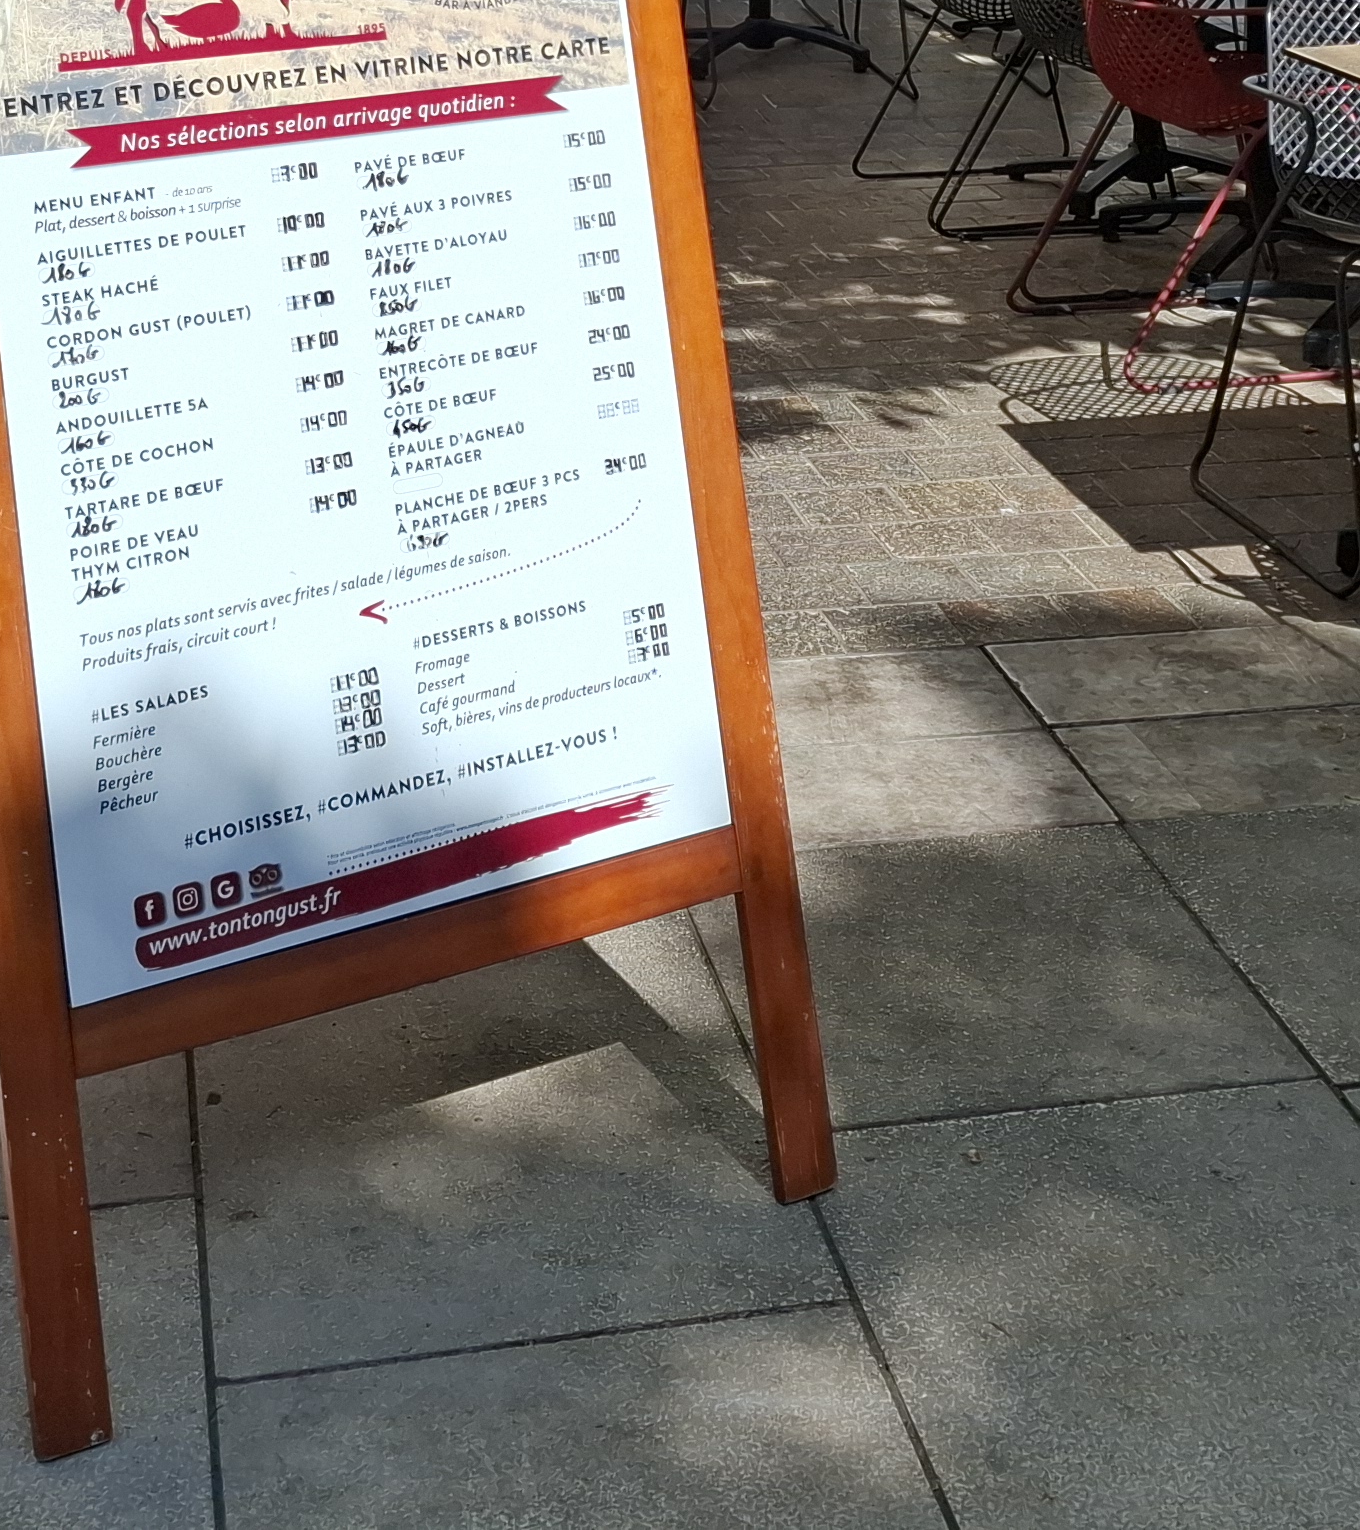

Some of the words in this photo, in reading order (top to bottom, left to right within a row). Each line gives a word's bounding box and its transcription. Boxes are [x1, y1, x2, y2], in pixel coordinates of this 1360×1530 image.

[60, 49, 111, 63] DEPUIS
[357, 23, 386, 35] 1895
[4, 88, 104, 117] ENTREZ
[115, 85, 141, 105] ET
[153, 68, 305, 101] DÉCOUVREZ
[316, 64, 345, 83] EN
[355, 54, 448, 77] VITRINE
[457, 45, 530, 69] NOTRE
[541, 37, 607, 59] CARTE
[121, 133, 159, 152] Nos
[167, 121, 268, 146] sélections
[275, 113, 326, 134] selon
[333, 106, 411, 127] arrivage
[418, 93, 503, 122] quotidien
[354, 154, 392, 173] PAVÉ
[397, 154, 416, 170] DE
[422, 148, 465, 165] BŒUF
[33, 195, 83, 214] MENU
[90, 186, 155, 206] ENFANT
[360, 201, 398, 221] PAVÉ
[403, 199, 433, 215] AUX
[451, 189, 512, 209] POIVRES
[37, 237, 152, 265] AIGUILLETTES
[158, 233, 179, 248] DE
[185, 224, 245, 245] POULET
[364, 240, 429, 260] BAVETTE
[434, 229, 507, 250] D'ALOYAU
[42, 287, 95, 307] STEAK
[100, 275, 159, 298] HACHÉ
[369, 282, 409, 300] FAUX
[414, 276, 451, 293] FILET
[46, 325, 122, 349] CORDON
[128, 318, 170, 336] GUST
[176, 304, 251, 331] (POULET)
[374, 318, 434, 340] MAGRET
[440, 314, 460, 329] DE
[464, 305, 525, 325] CANARD
[378, 353, 466, 379] ENTRECÔTE
[471, 349, 490, 364] DE
[494, 342, 537, 360] BŒUF
[51, 367, 128, 391] BURGUST
[55, 401, 182, 434] ANDOUILLETTE
[187, 397, 208, 411] 5A
[383, 401, 423, 419] CÔTE
[428, 397, 447, 411] DE
[452, 388, 496, 407] BŒUF
[60, 456, 105, 476] CÔTE
[111, 452, 133, 467] DE
[139, 437, 213, 462] COCHON
[388, 436, 444, 458] ÉPAULE
[390, 460, 400, 477] À
[405, 448, 482, 474] PARTAGER
[64, 493, 140, 519] TARTARE
[146, 488, 168, 504] DE
[174, 478, 223, 499] BŒUF
[395, 491, 464, 516] PLANCHE
[469, 486, 488, 501] DE
[493, 477, 536, 496] BŒUF
[554, 468, 580, 484] PCS
[397, 517, 408, 535] À
[412, 505, 488, 532] PARTAGER
[504, 493, 547, 513] 2PERS
[69, 539, 121, 561] POIRE
[127, 534, 149, 550] DE
[154, 524, 198, 544] VEAU
[71, 560, 119, 581] THYM
[126, 546, 189, 570] CITRON
[79, 631, 113, 647] Tous
[117, 625, 141, 639] nos
[145, 616, 180, 637] plats
[184, 607, 214, 625] sont
[217, 598, 256, 617] servis
[260, 594, 291, 608] avec
[293, 585, 329, 600] frites
[340, 571, 383, 591] salade
[394, 560, 446, 582] légumes
[450, 554, 465, 568] de
[467, 548, 510, 564] saison.
[413, 620, 494, 649] #DESSERTS
[513, 600, 586, 627] BOISSONS
[82, 648, 142, 671] Produits
[143, 639, 182, 662] frais,
[187, 627, 229, 648] circuit
[233, 619, 268, 638] court
[415, 653, 469, 674] Fromage
[417, 673, 465, 694] Dessert
[419, 695, 448, 715] Café
[451, 679, 515, 711] gourmand
[91, 703, 129, 723] #LES
[135, 685, 208, 713] SALADES
[422, 717, 452, 736] Soft,
[455, 710, 495, 726] bières,
[498, 701, 522, 716] vins
[525, 696, 539, 710] de
[542, 681, 611, 710] producteurs
[93, 725, 155, 749] Fermière
[95, 745, 161, 770] Bouchère
[98, 770, 153, 793] Bergère
[184, 804, 310, 848] #CHOISISSEZ,
[318, 769, 451, 814] #COMMANDEZ,
[458, 728, 606, 778] #INSTALLEZ-VOUS
[100, 791, 158, 814] Pêcheur
[149, 886, 340, 956] www.tontongust.fr
